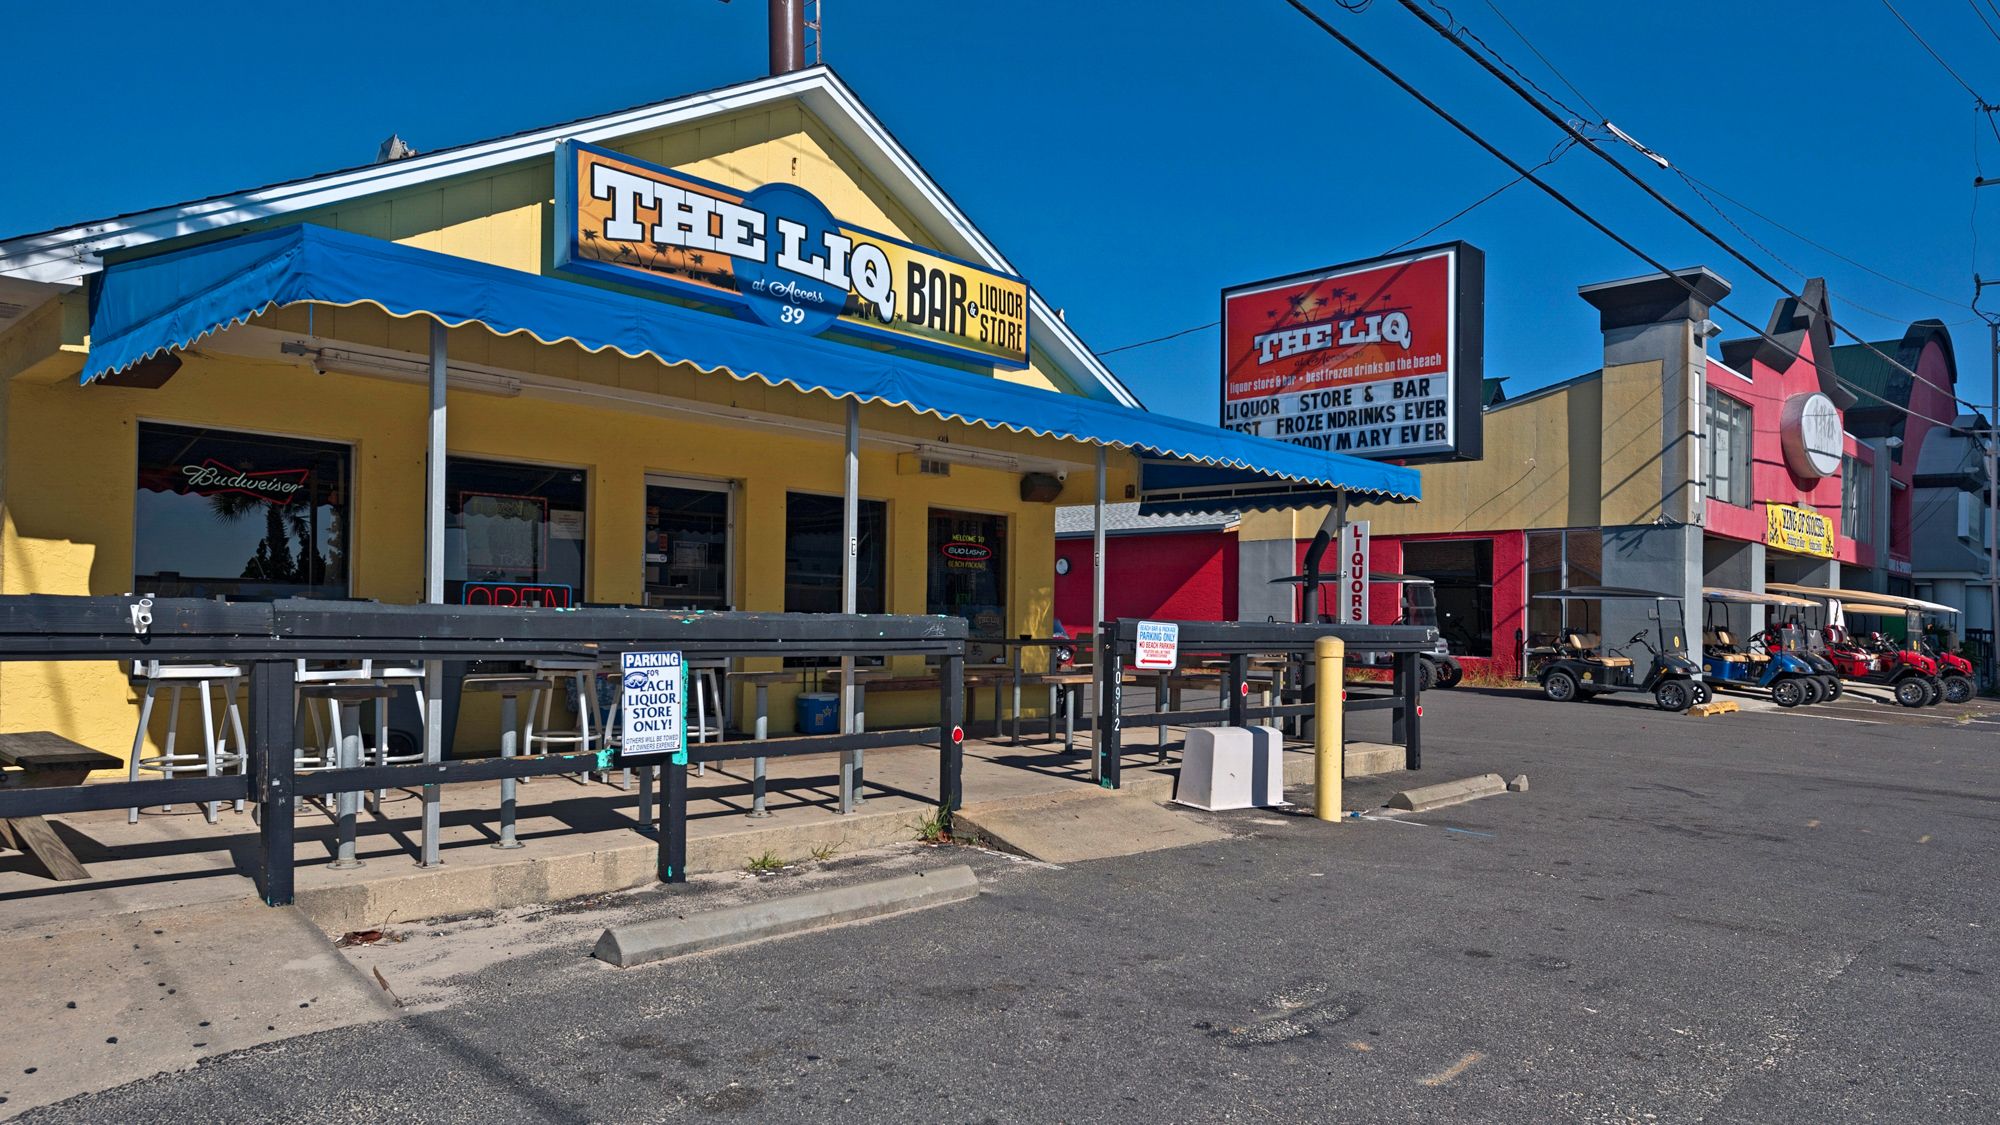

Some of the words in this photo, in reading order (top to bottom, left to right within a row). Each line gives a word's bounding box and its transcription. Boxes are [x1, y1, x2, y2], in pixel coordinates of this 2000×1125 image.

[591, 162, 766, 262] THE
[776, 217, 896, 323] LIQ
[752, 277, 766, 292] at
[769, 280, 824, 304] Access
[906, 261, 967, 337] BAR
[967, 300, 979, 319] &
[979, 281, 1023, 320] LIQUOR
[780, 305, 805, 325] 39
[979, 320, 1023, 352] STORE
[1254, 323, 1332, 366] THE
[1338, 311, 1412, 350] LIQ
[1230, 381, 1252, 394] liquor
[1253, 378, 1274, 391] store
[1282, 374, 1296, 386] bar
[1306, 369, 1324, 383] best
[1325, 365, 1352, 381] frozen
[1355, 361, 1383, 376] drinks
[1385, 361, 1395, 372] on
[1397, 357, 1411, 370] the
[1413, 353, 1441, 368] beach
[1226, 398, 1280, 420] LIQUOR
[1300, 388, 1352, 412] STORE
[1364, 385, 1374, 402] &
[1393, 378, 1430, 399] BAR
[1405, 400, 1446, 420] EVER
[1401, 423, 1446, 443] EVER
[182, 466, 304, 494] Budweiser
[947, 547, 965, 555] BUD
[965, 548, 987, 556] LIGHT
[1351, 525, 1363, 621] LIQUORS
[1140, 632, 1162, 641] PARKING
[1163, 633, 1175, 642] ONLY
[626, 653, 679, 667] PARKING
[628, 693, 676, 707] LIQUOR
[633, 706, 672, 719] STORE
[633, 719, 672, 732] ONLY!
[626, 737, 644, 745] OTHERS
[663, 734, 678, 742] TOWED
[636, 743, 655, 751] OWNERS
[656, 741, 676, 749] EXPENSE
